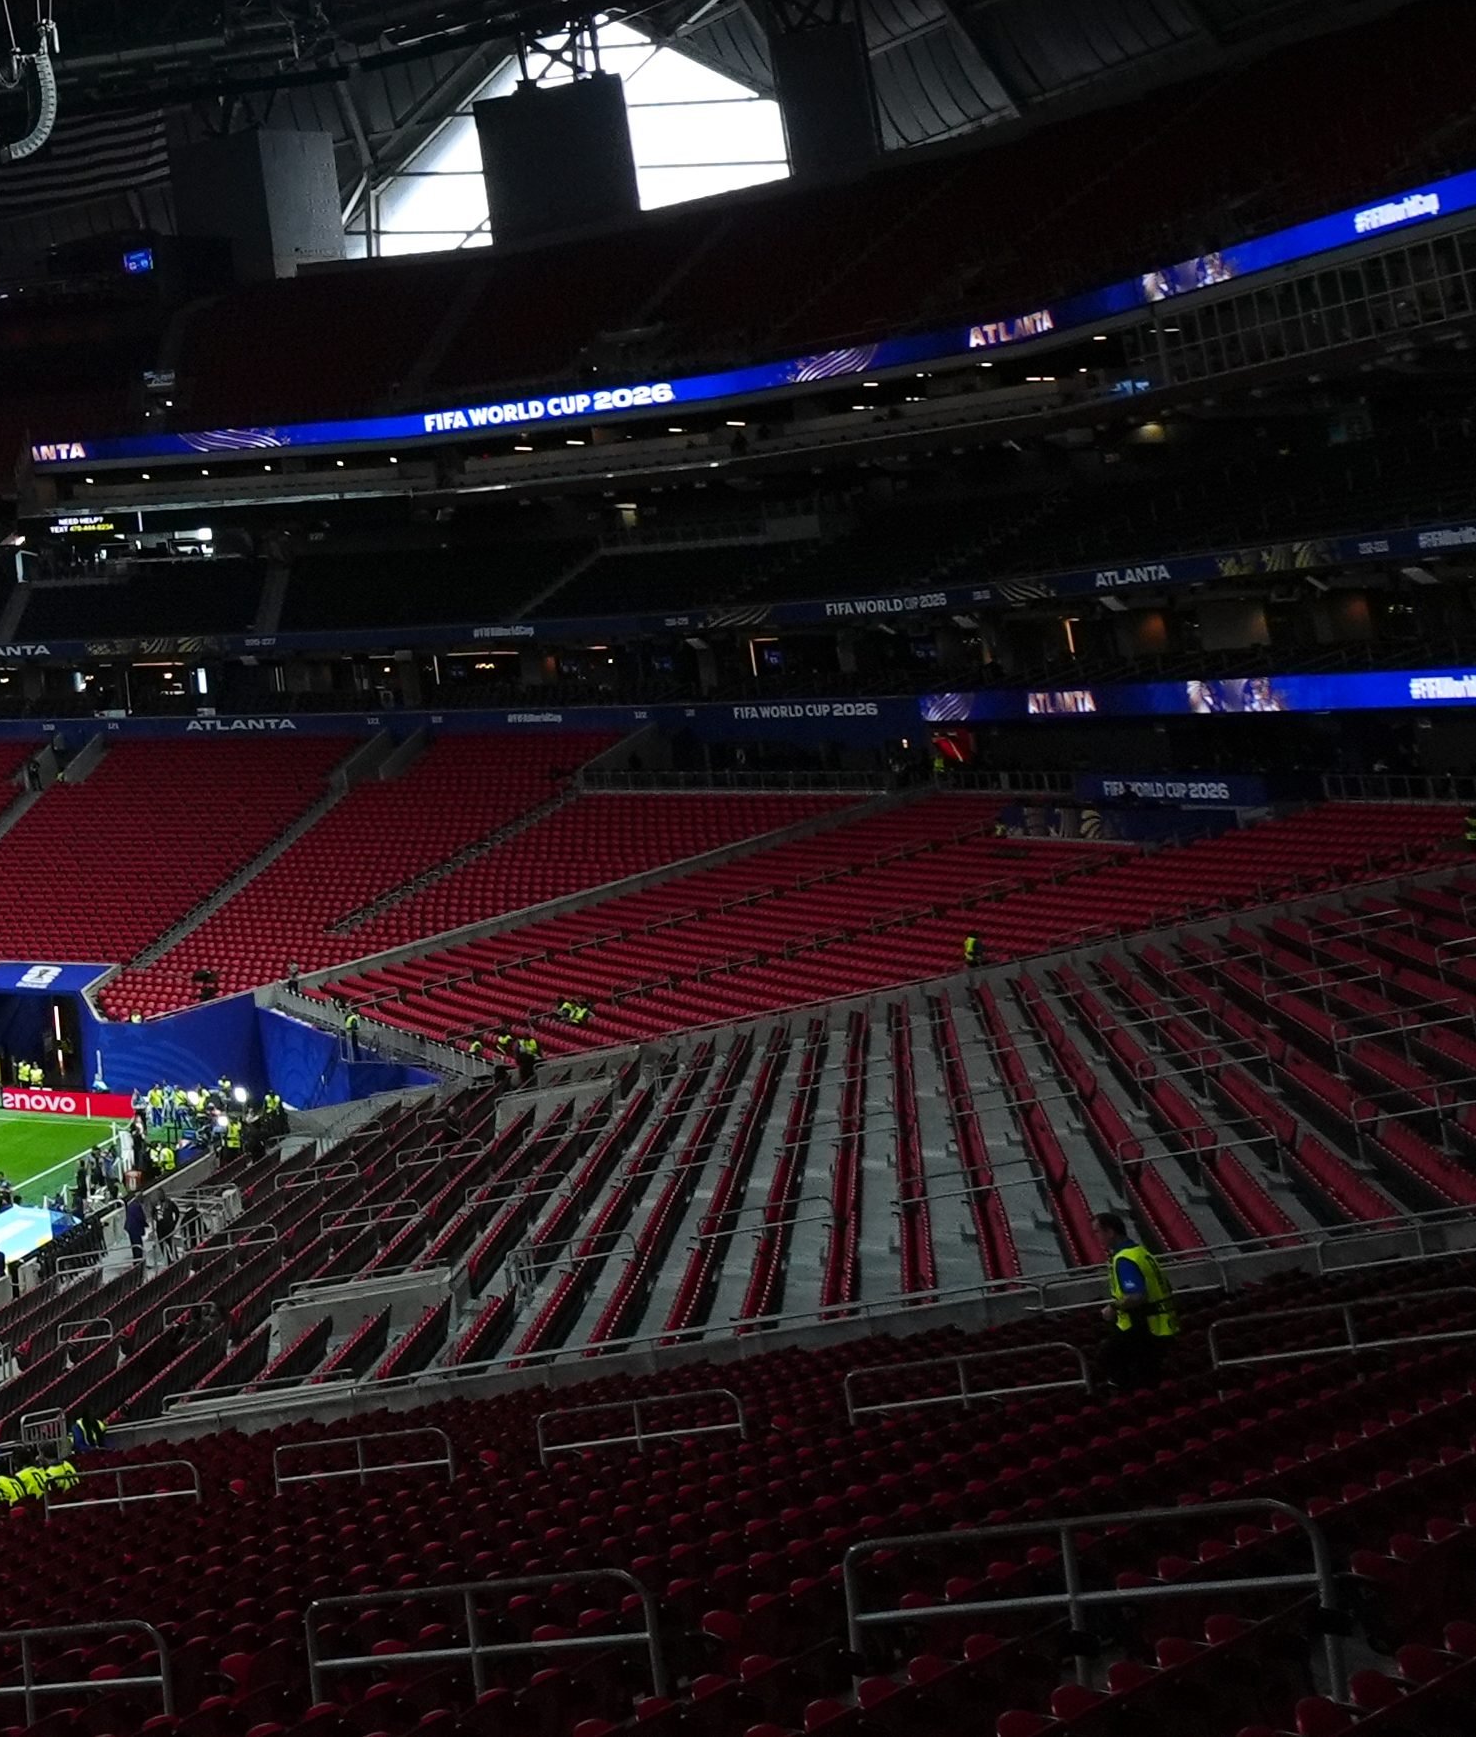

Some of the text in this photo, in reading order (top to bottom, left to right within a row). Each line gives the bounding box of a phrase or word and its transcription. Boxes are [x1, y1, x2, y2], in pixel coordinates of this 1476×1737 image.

[970, 310, 1054, 347] ATLANTA
[423, 383, 675, 432] FIFA WORLD CUP 2026
[49, 525, 69, 534] TEXT
[58, 516, 104, 526] NEED HELP?
[1095, 565, 1170, 588] ATLANTA
[826, 601, 852, 616] FIFA
[855, 597, 902, 614] WORLD
[919, 592, 946, 609] 2026
[733, 702, 878, 719] FIFA WORLD CUP 2026
[1027, 692, 1096, 713] ATLANTA
[186, 718, 296, 731] ATLANTA
[1102, 781, 1124, 796] FIFA
[1163, 781, 1188, 798] CUP
[1190, 782, 1229, 800] 2026
